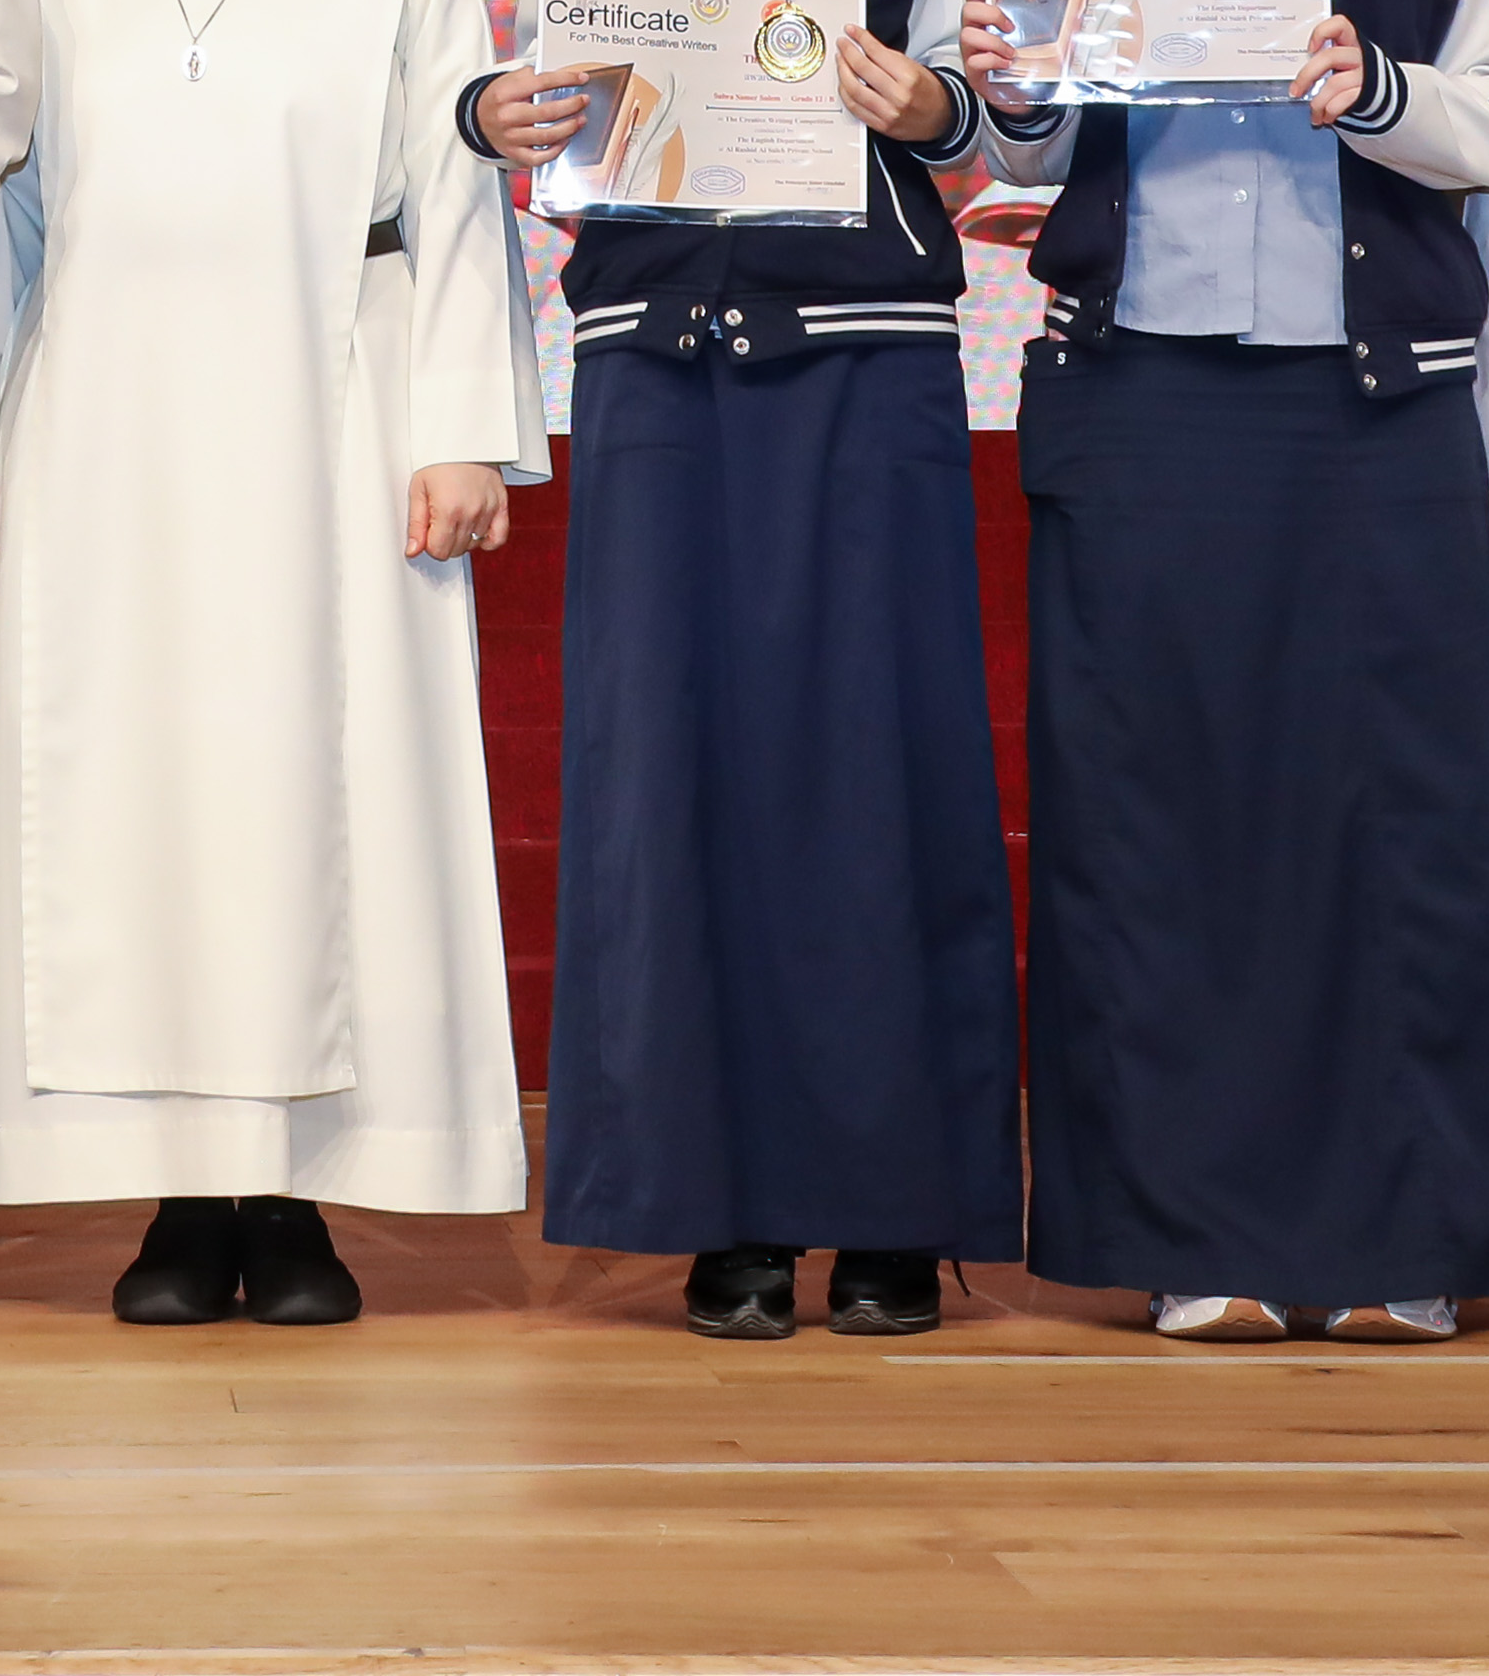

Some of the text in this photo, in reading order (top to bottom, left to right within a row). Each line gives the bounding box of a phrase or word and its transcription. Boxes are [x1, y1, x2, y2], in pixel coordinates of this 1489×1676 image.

[546, 0, 690, 33] Certificate
[569, 32, 718, 52] For The Best Creative Writers
[1057, 352, 1066, 365] S
